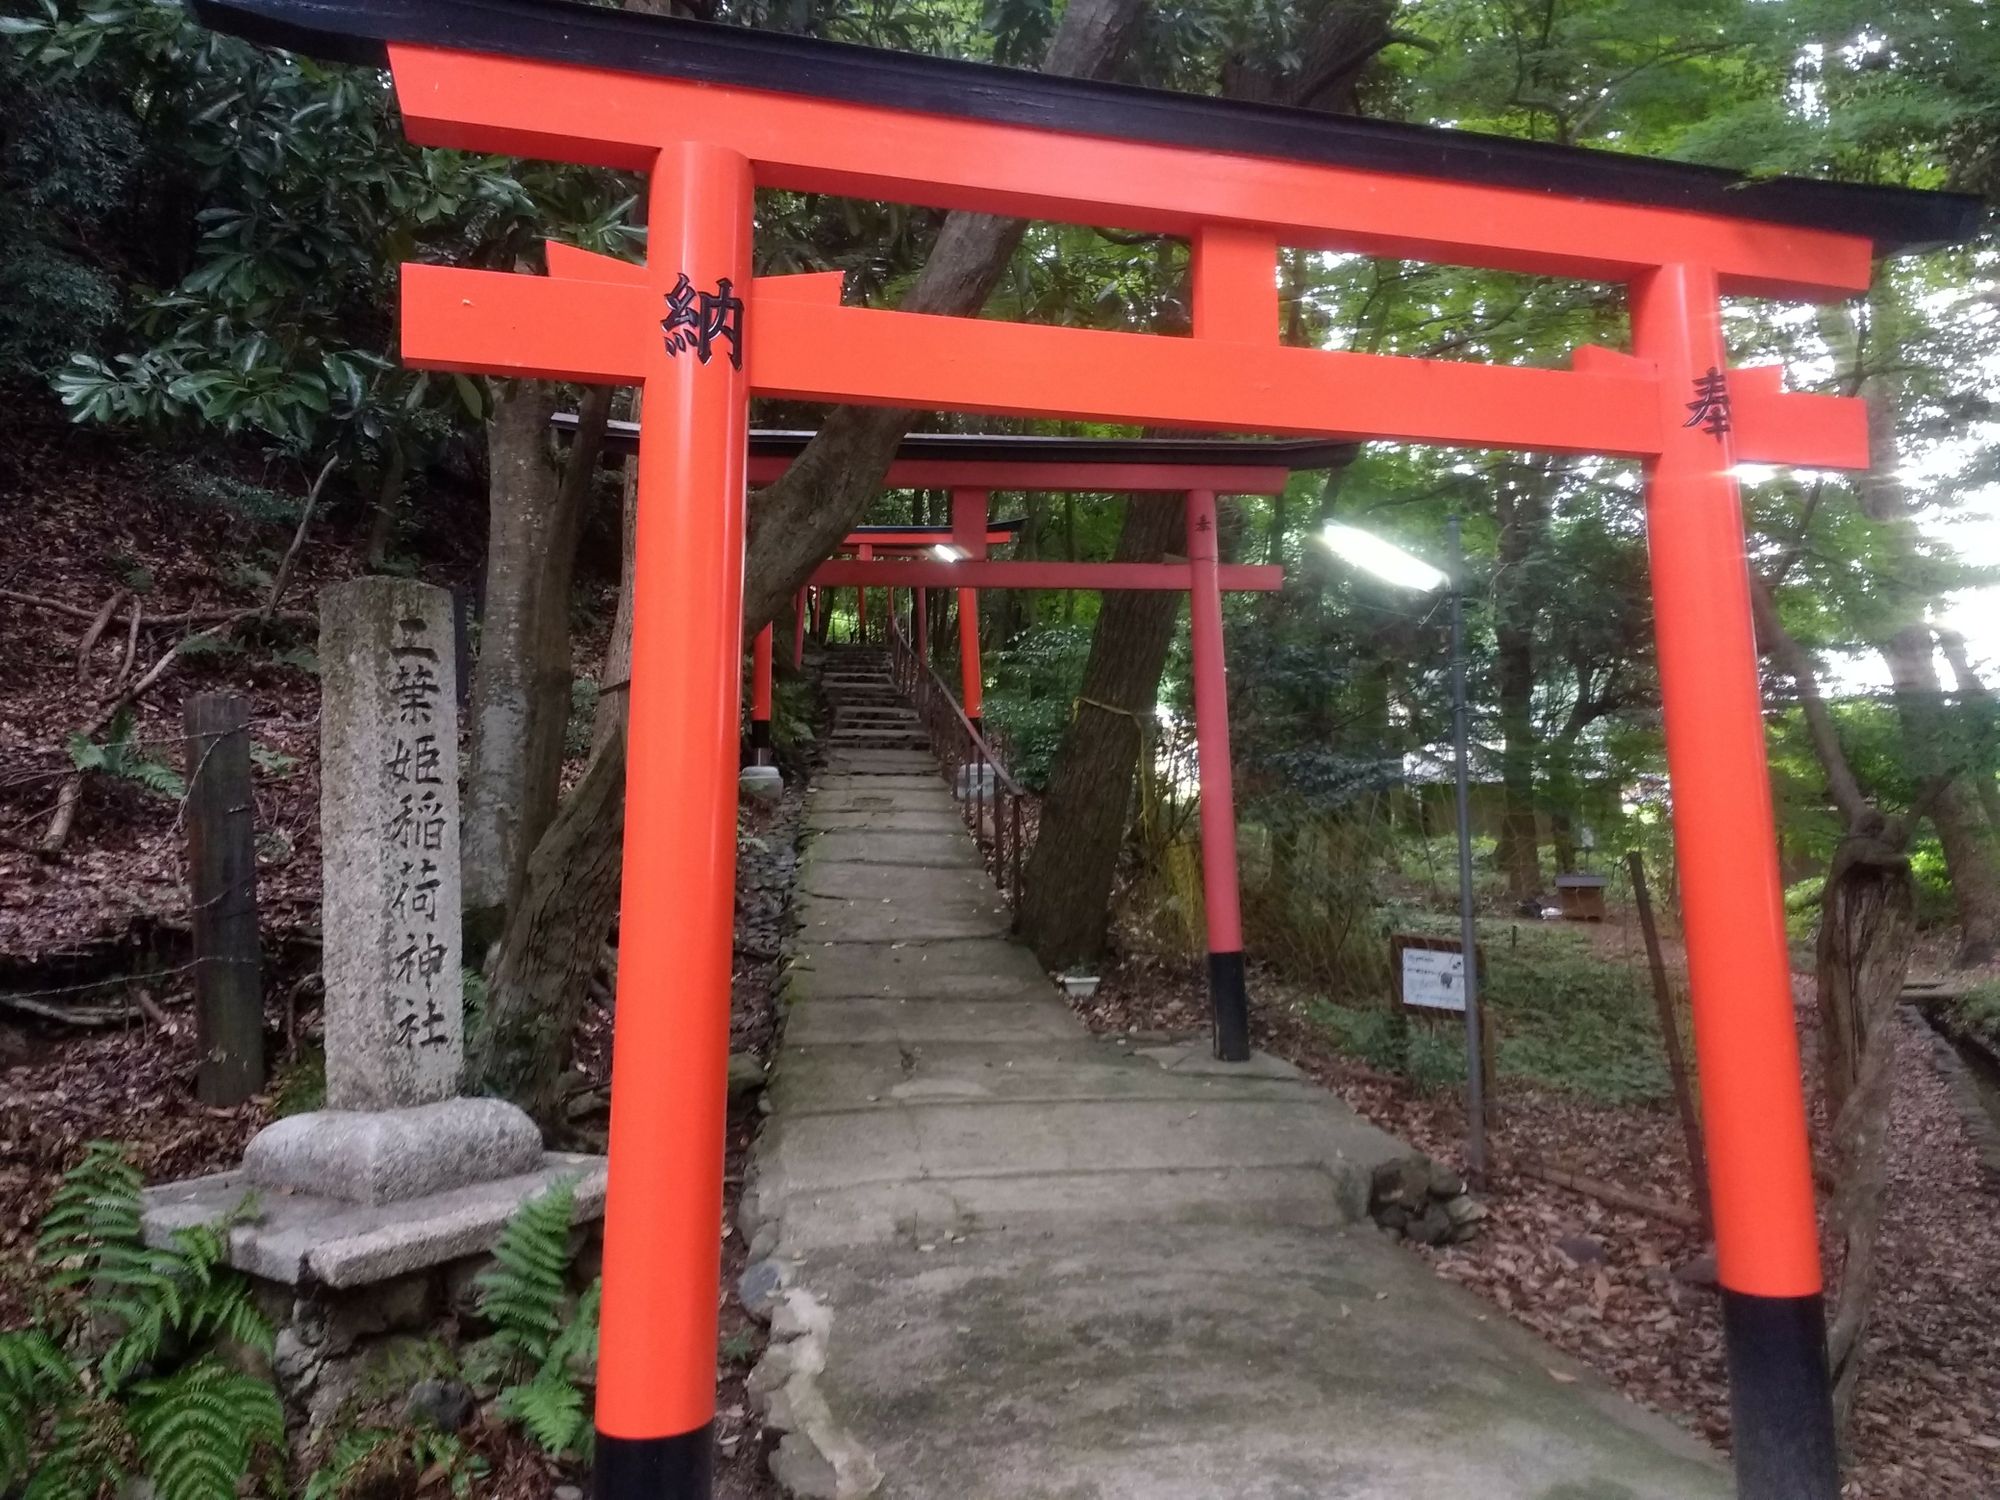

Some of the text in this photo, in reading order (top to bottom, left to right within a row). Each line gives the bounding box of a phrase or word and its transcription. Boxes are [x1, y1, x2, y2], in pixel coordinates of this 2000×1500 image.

[660, 272, 744, 373] 納
[385, 617, 449, 1050] 二葉姫稲荷神社
